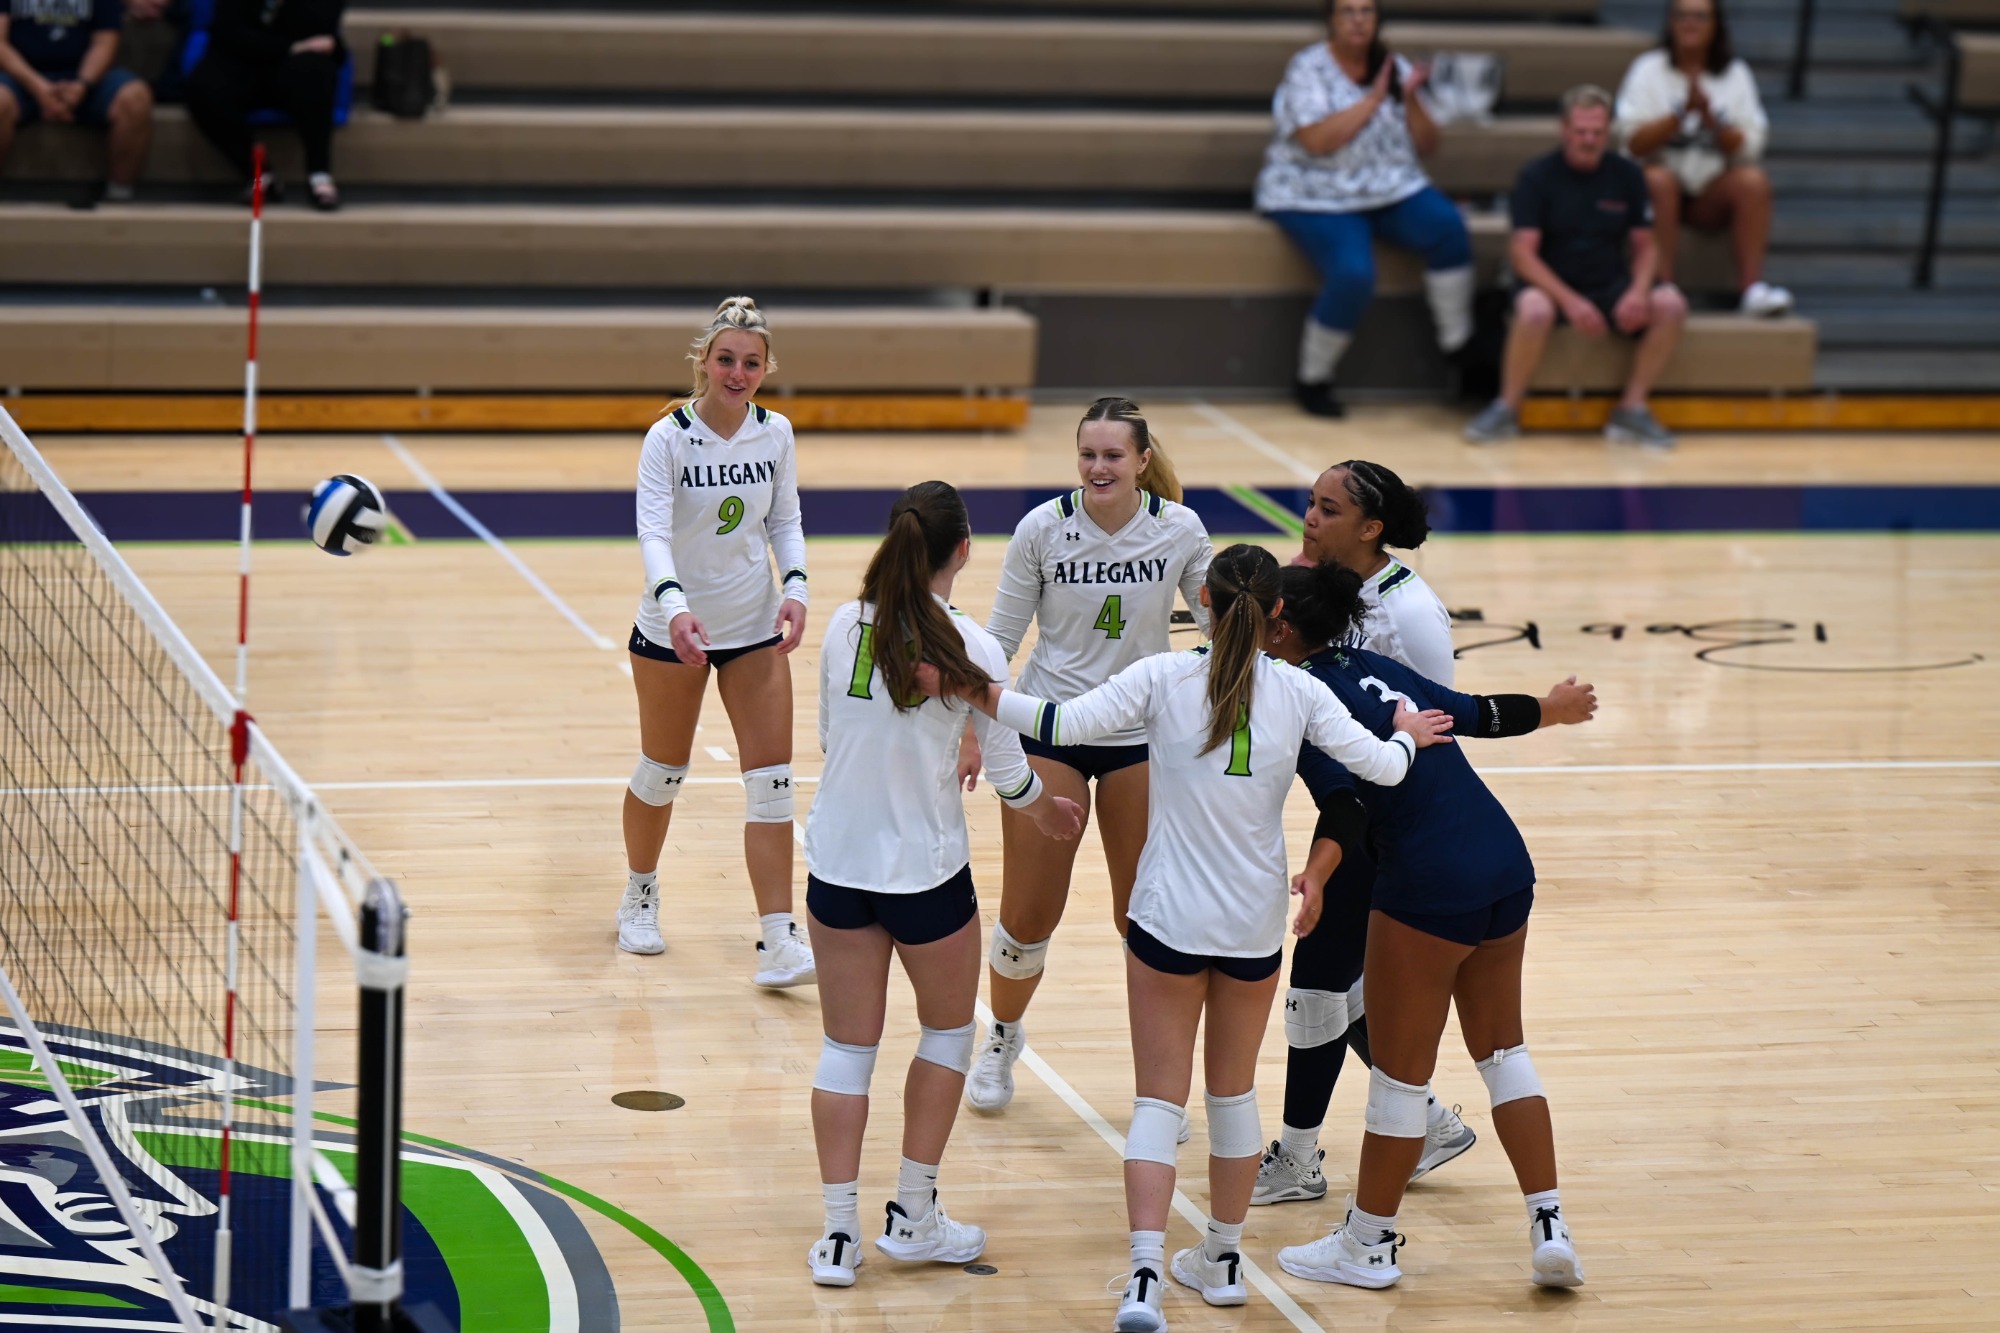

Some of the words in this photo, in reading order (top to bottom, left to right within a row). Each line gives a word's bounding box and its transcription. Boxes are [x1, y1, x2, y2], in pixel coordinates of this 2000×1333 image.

[680, 460, 777, 488] ALLEGANY
[716, 495, 745, 535] 9
[1053, 558, 1168, 584] ALLEGANY
[1093, 594, 1127, 639] 4
[847, 621, 932, 708] 1
[1223, 700, 1253, 777] 1
